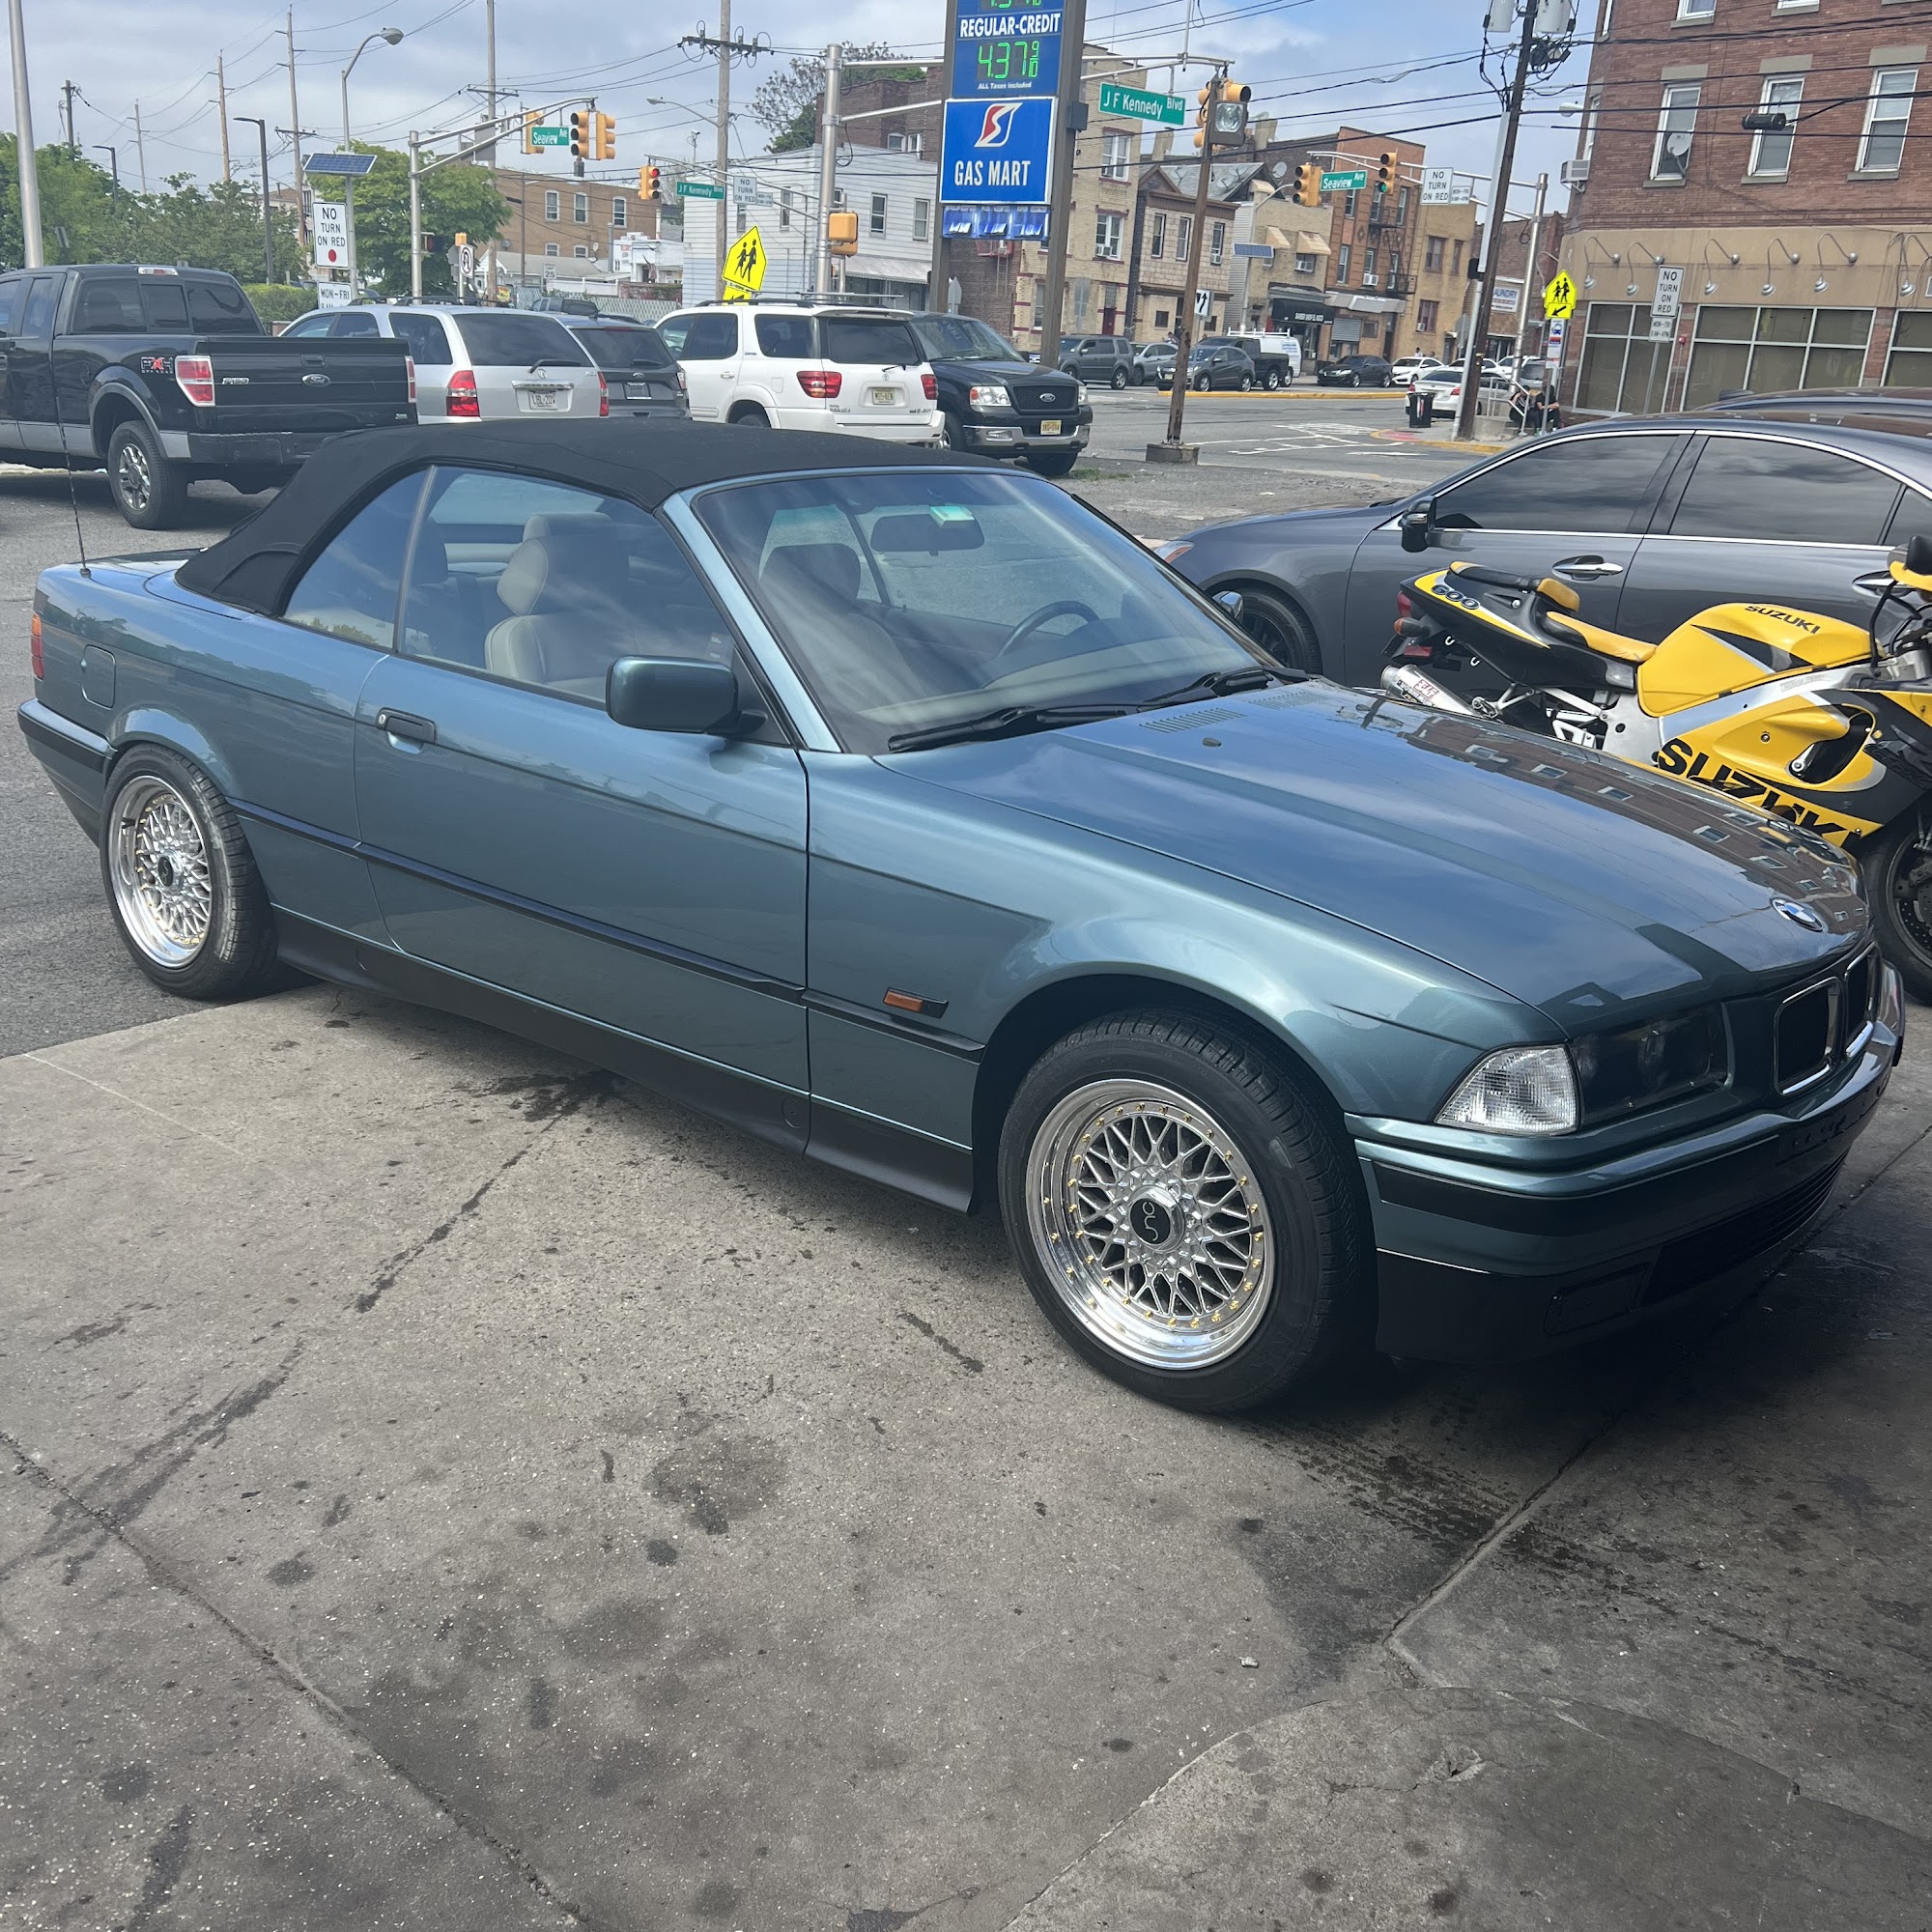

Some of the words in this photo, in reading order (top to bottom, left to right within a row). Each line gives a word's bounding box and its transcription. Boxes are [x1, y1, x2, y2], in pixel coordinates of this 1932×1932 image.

[959, 13, 1061, 38] REGULAR-CREDIT
[1103, 91, 1111, 107] J
[1113, 93, 1121, 108] F
[1122, 94, 1163, 120] Kennedy
[1166, 97, 1183, 111] Blvd
[533, 131, 558, 145] Seaview
[559, 128, 568, 137] Ave
[954, 160, 983, 186] GAS
[987, 160, 1032, 186] MART
[1323, 177, 1352, 189] Seaview
[1354, 172, 1364, 181] Ave
[1429, 182, 1447, 190] TURN
[689, 186, 713, 197] Kennedy
[322, 207, 337, 220] NO
[321, 222, 341, 234] TURN
[317, 236, 328, 246] ON
[330, 237, 346, 247] RED
[1662, 270, 1678, 281] NO
[320, 288, 350, 300] MON-FRI
[1493, 288, 1518, 299] AUNDRY
[1660, 283, 1679, 293] TURN
[1662, 294, 1672, 303] ON
[1658, 304, 1672, 314] RED
[1745, 605, 1821, 635] SUZUKI
